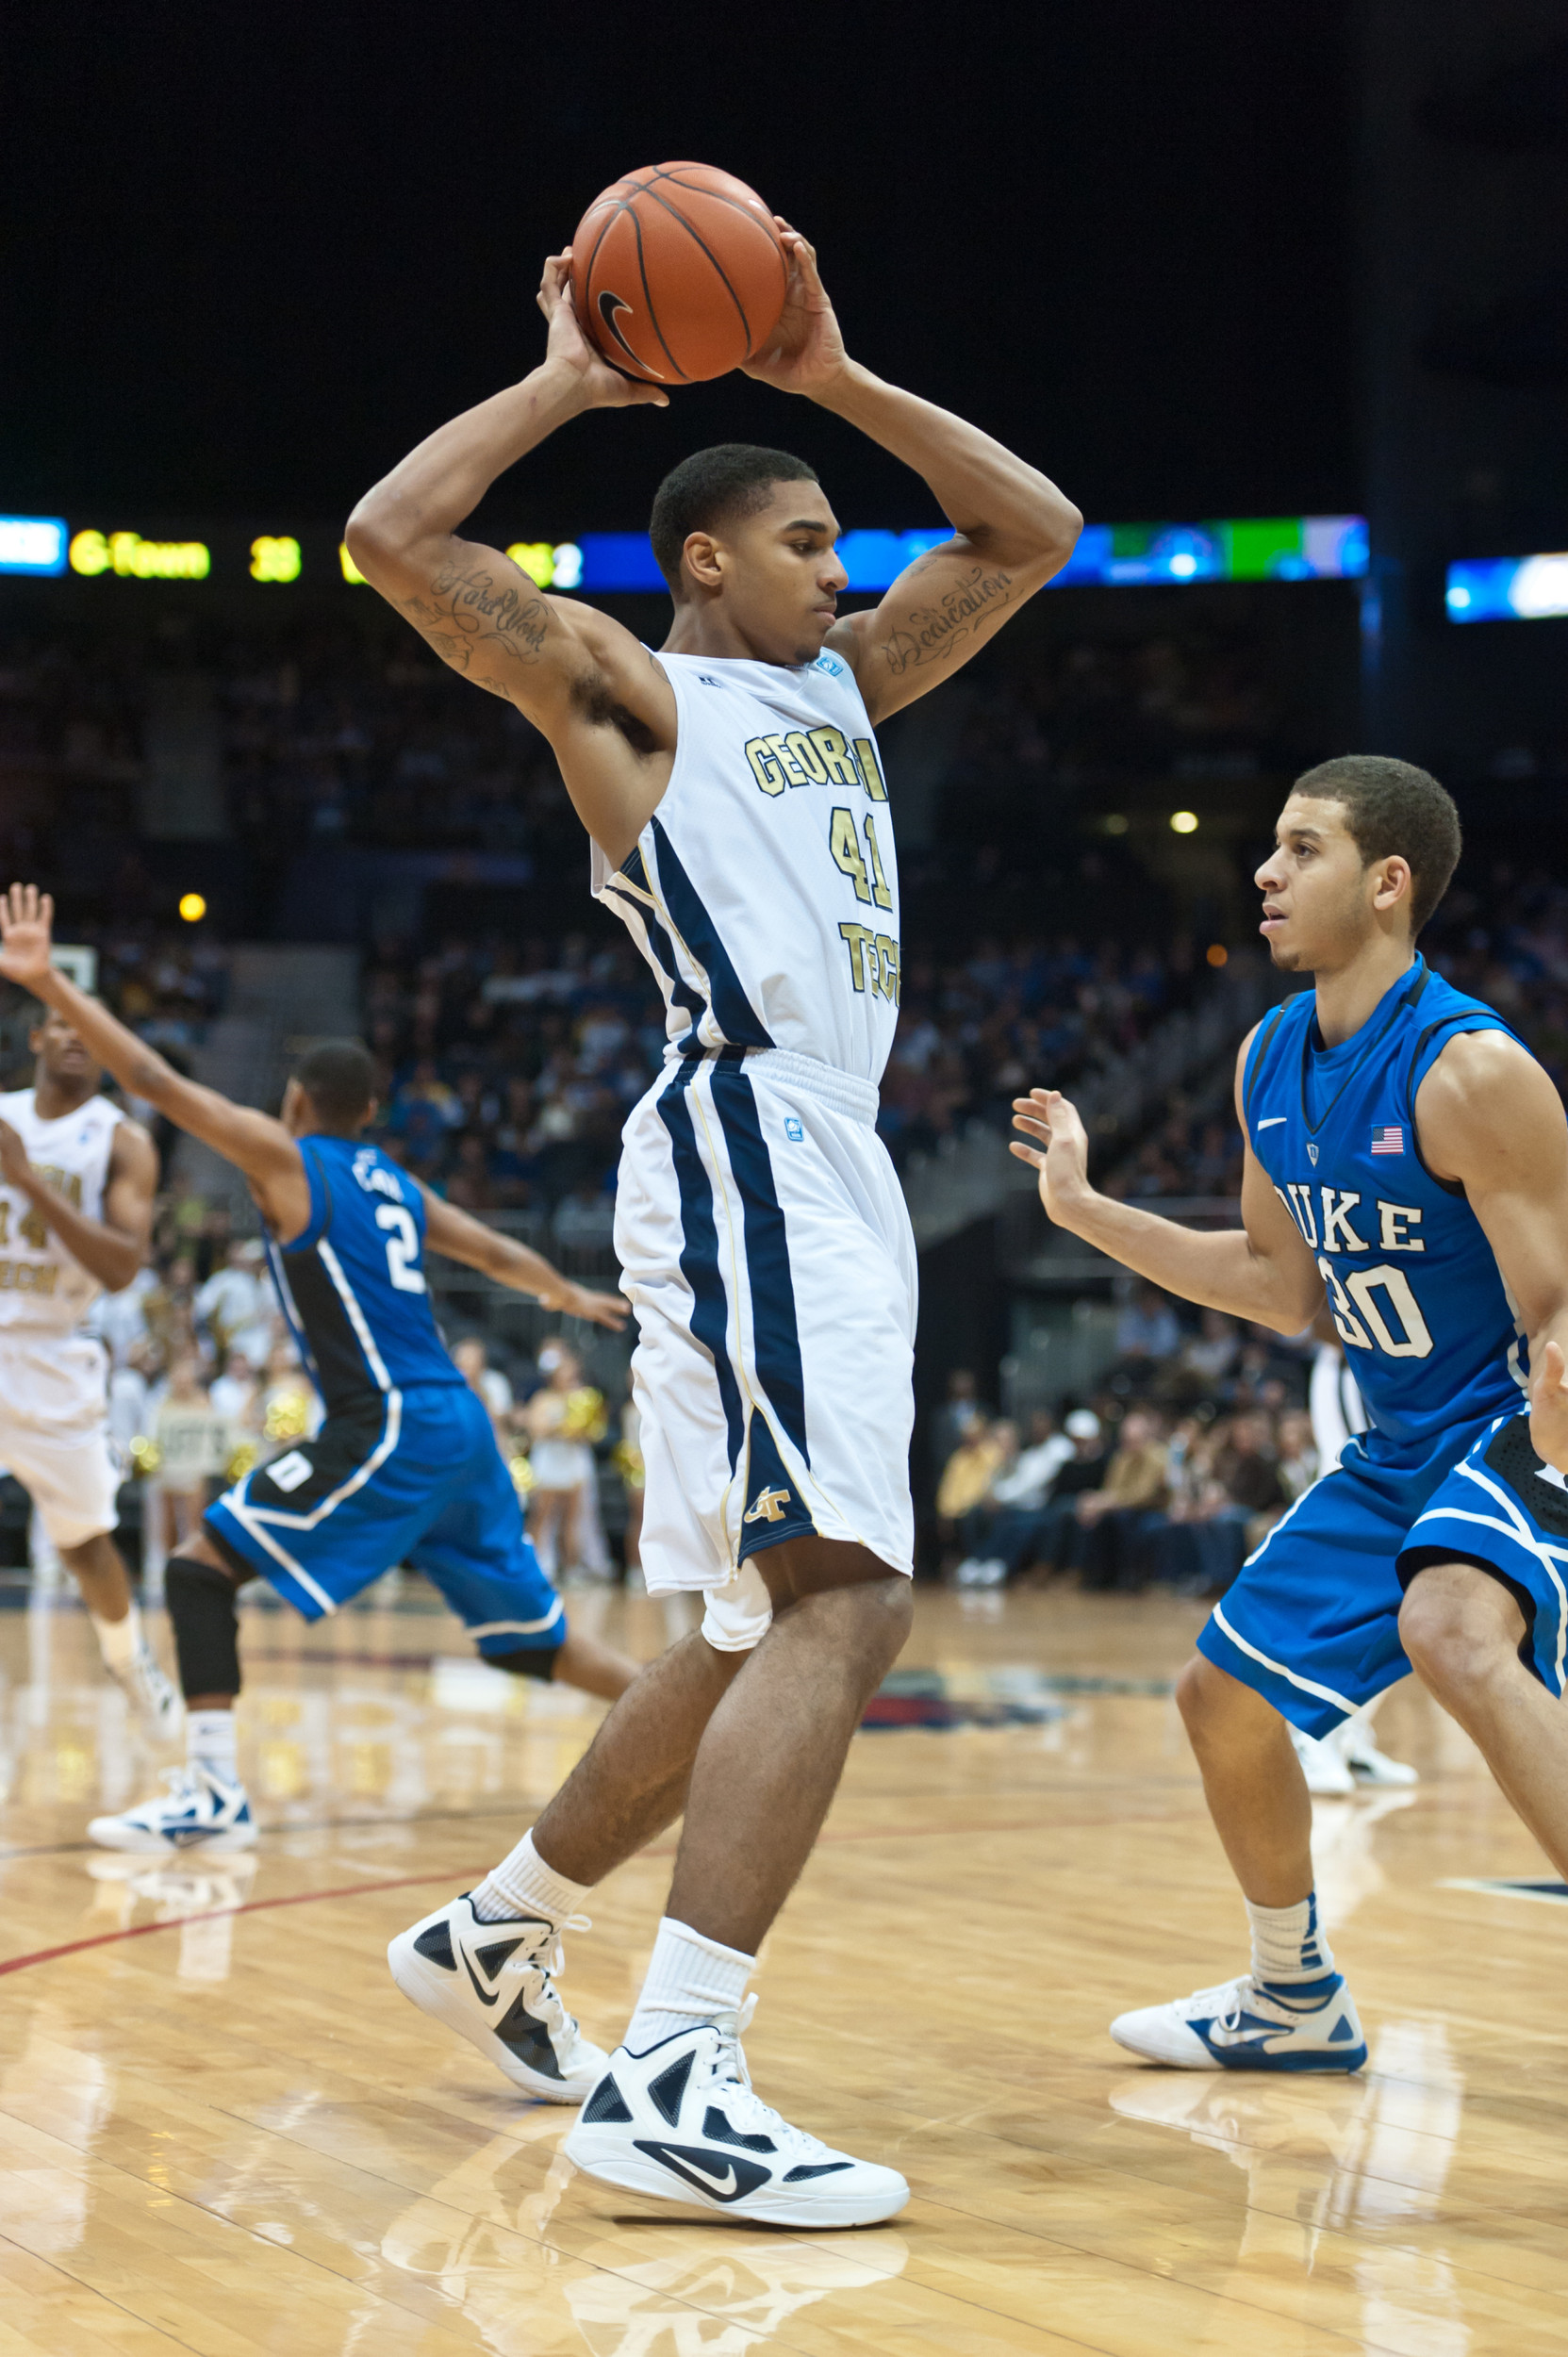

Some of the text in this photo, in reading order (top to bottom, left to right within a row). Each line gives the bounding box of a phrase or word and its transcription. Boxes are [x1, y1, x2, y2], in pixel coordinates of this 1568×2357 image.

[830, 806, 893, 913] 41
[375, 1203, 425, 1294] 2
[1273, 1182, 1427, 1254] UKE
[1317, 1255, 1434, 1359] 30
